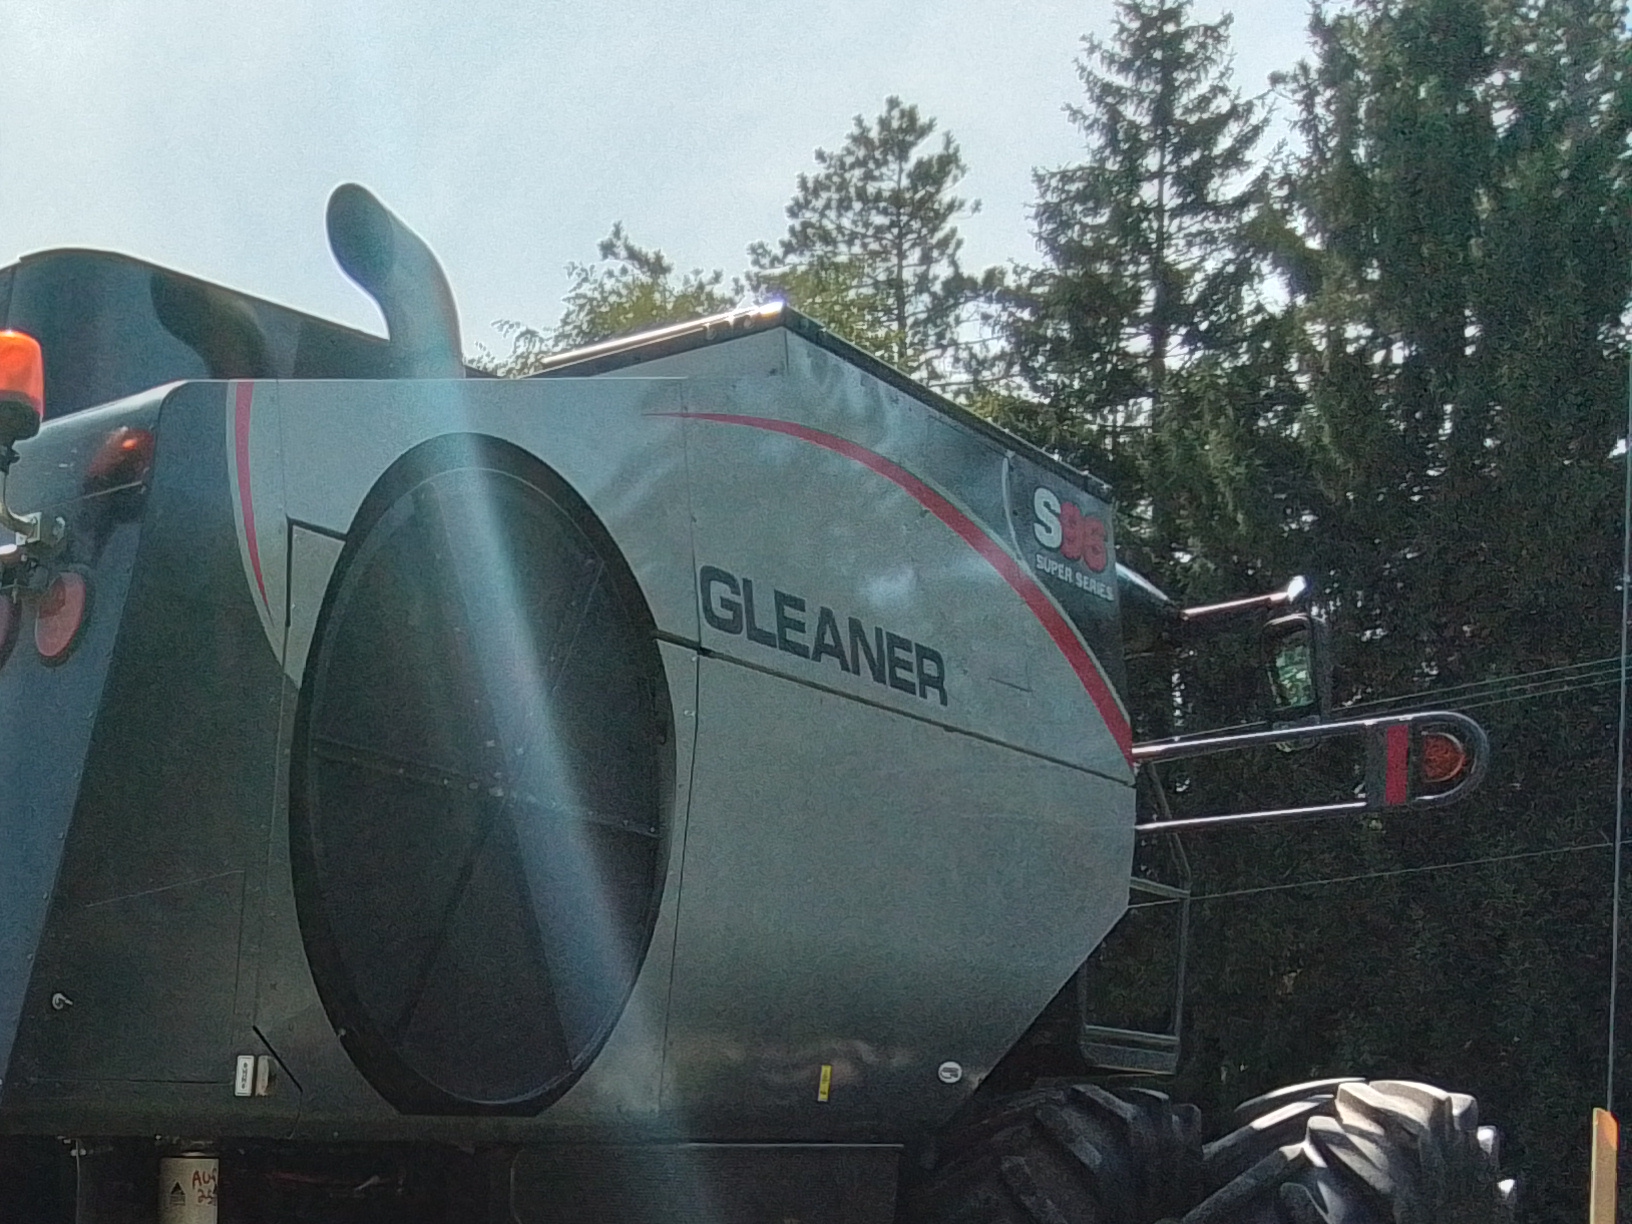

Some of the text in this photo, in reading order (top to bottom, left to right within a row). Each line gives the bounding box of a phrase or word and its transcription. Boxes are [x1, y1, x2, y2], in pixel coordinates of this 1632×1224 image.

[1036, 554, 1114, 601] SUPER SERIES
[699, 565, 948, 706] GLEANER
